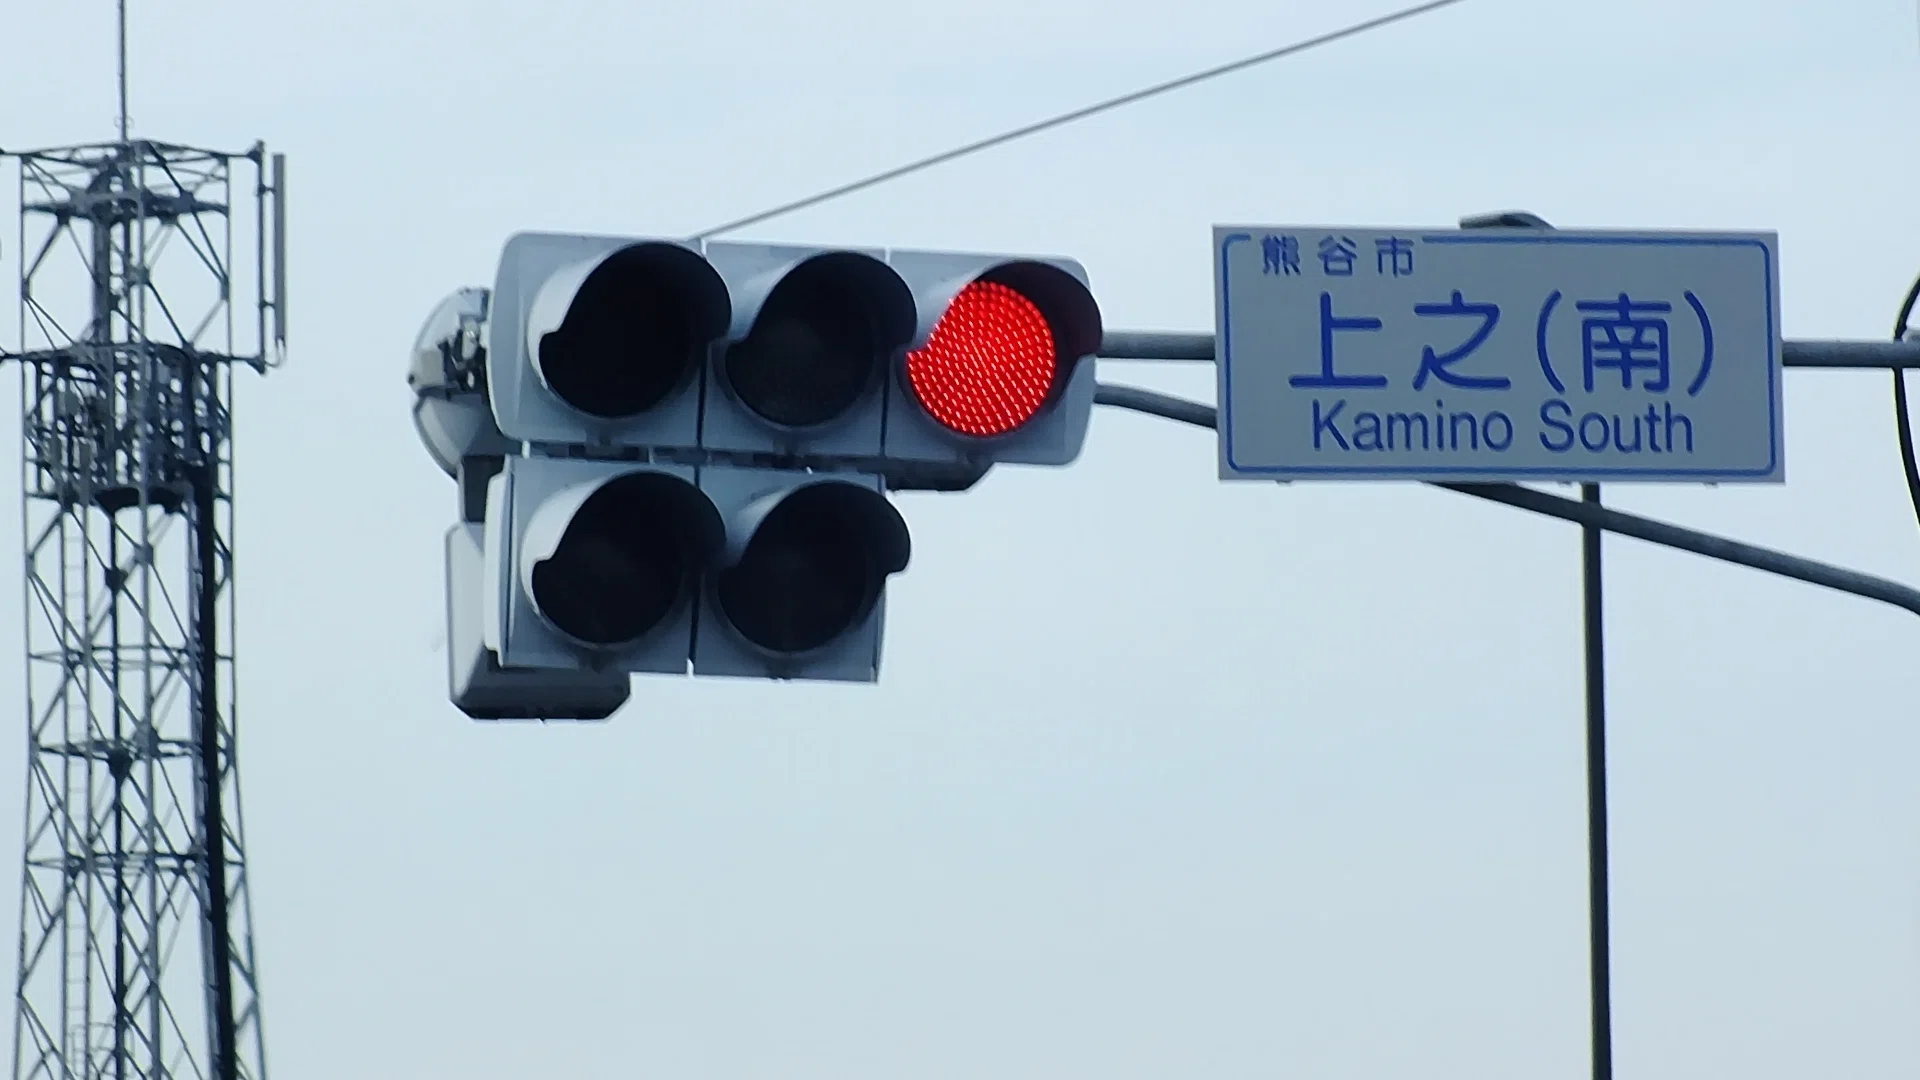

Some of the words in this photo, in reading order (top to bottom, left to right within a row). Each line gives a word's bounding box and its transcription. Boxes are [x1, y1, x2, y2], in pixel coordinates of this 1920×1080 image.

[1261, 235, 1416, 278] 熊谷市
[1288, 289, 1716, 398] 上之(南)
[1311, 399, 1515, 454] Kamino
[1537, 399, 1696, 455] South
